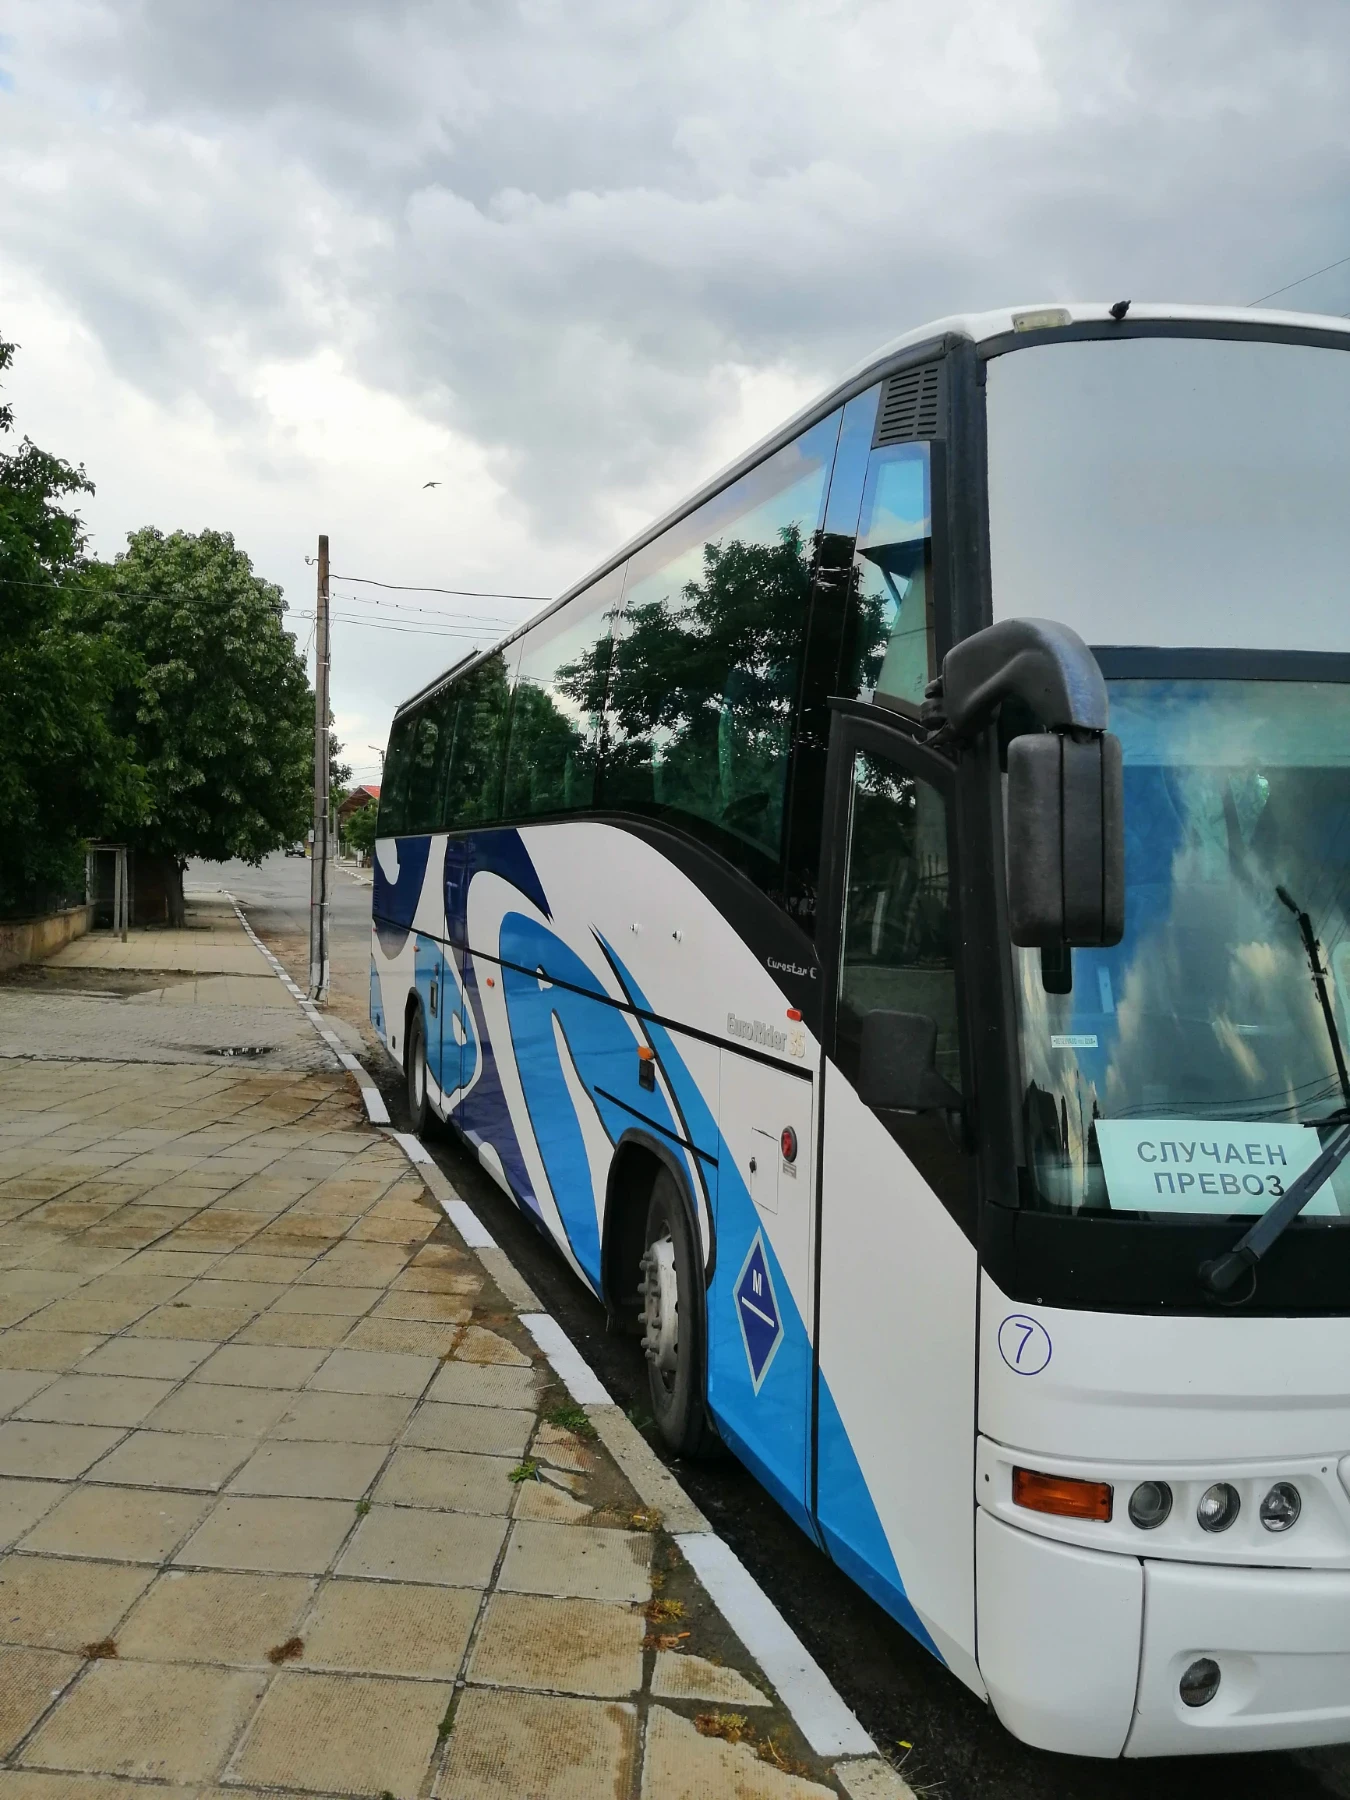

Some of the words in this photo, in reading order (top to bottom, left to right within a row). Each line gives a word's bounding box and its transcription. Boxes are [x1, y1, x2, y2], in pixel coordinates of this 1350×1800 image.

[727, 1012, 787, 1052] EuroRider
[789, 1028, 806, 1058] 35
[1137, 1141, 1288, 1166] СЛУЧАЕН
[1154, 1172, 1285, 1197] ПРЕВОЗ
[752, 1268, 763, 1297] M
[1015, 1322, 1034, 1364] 7
